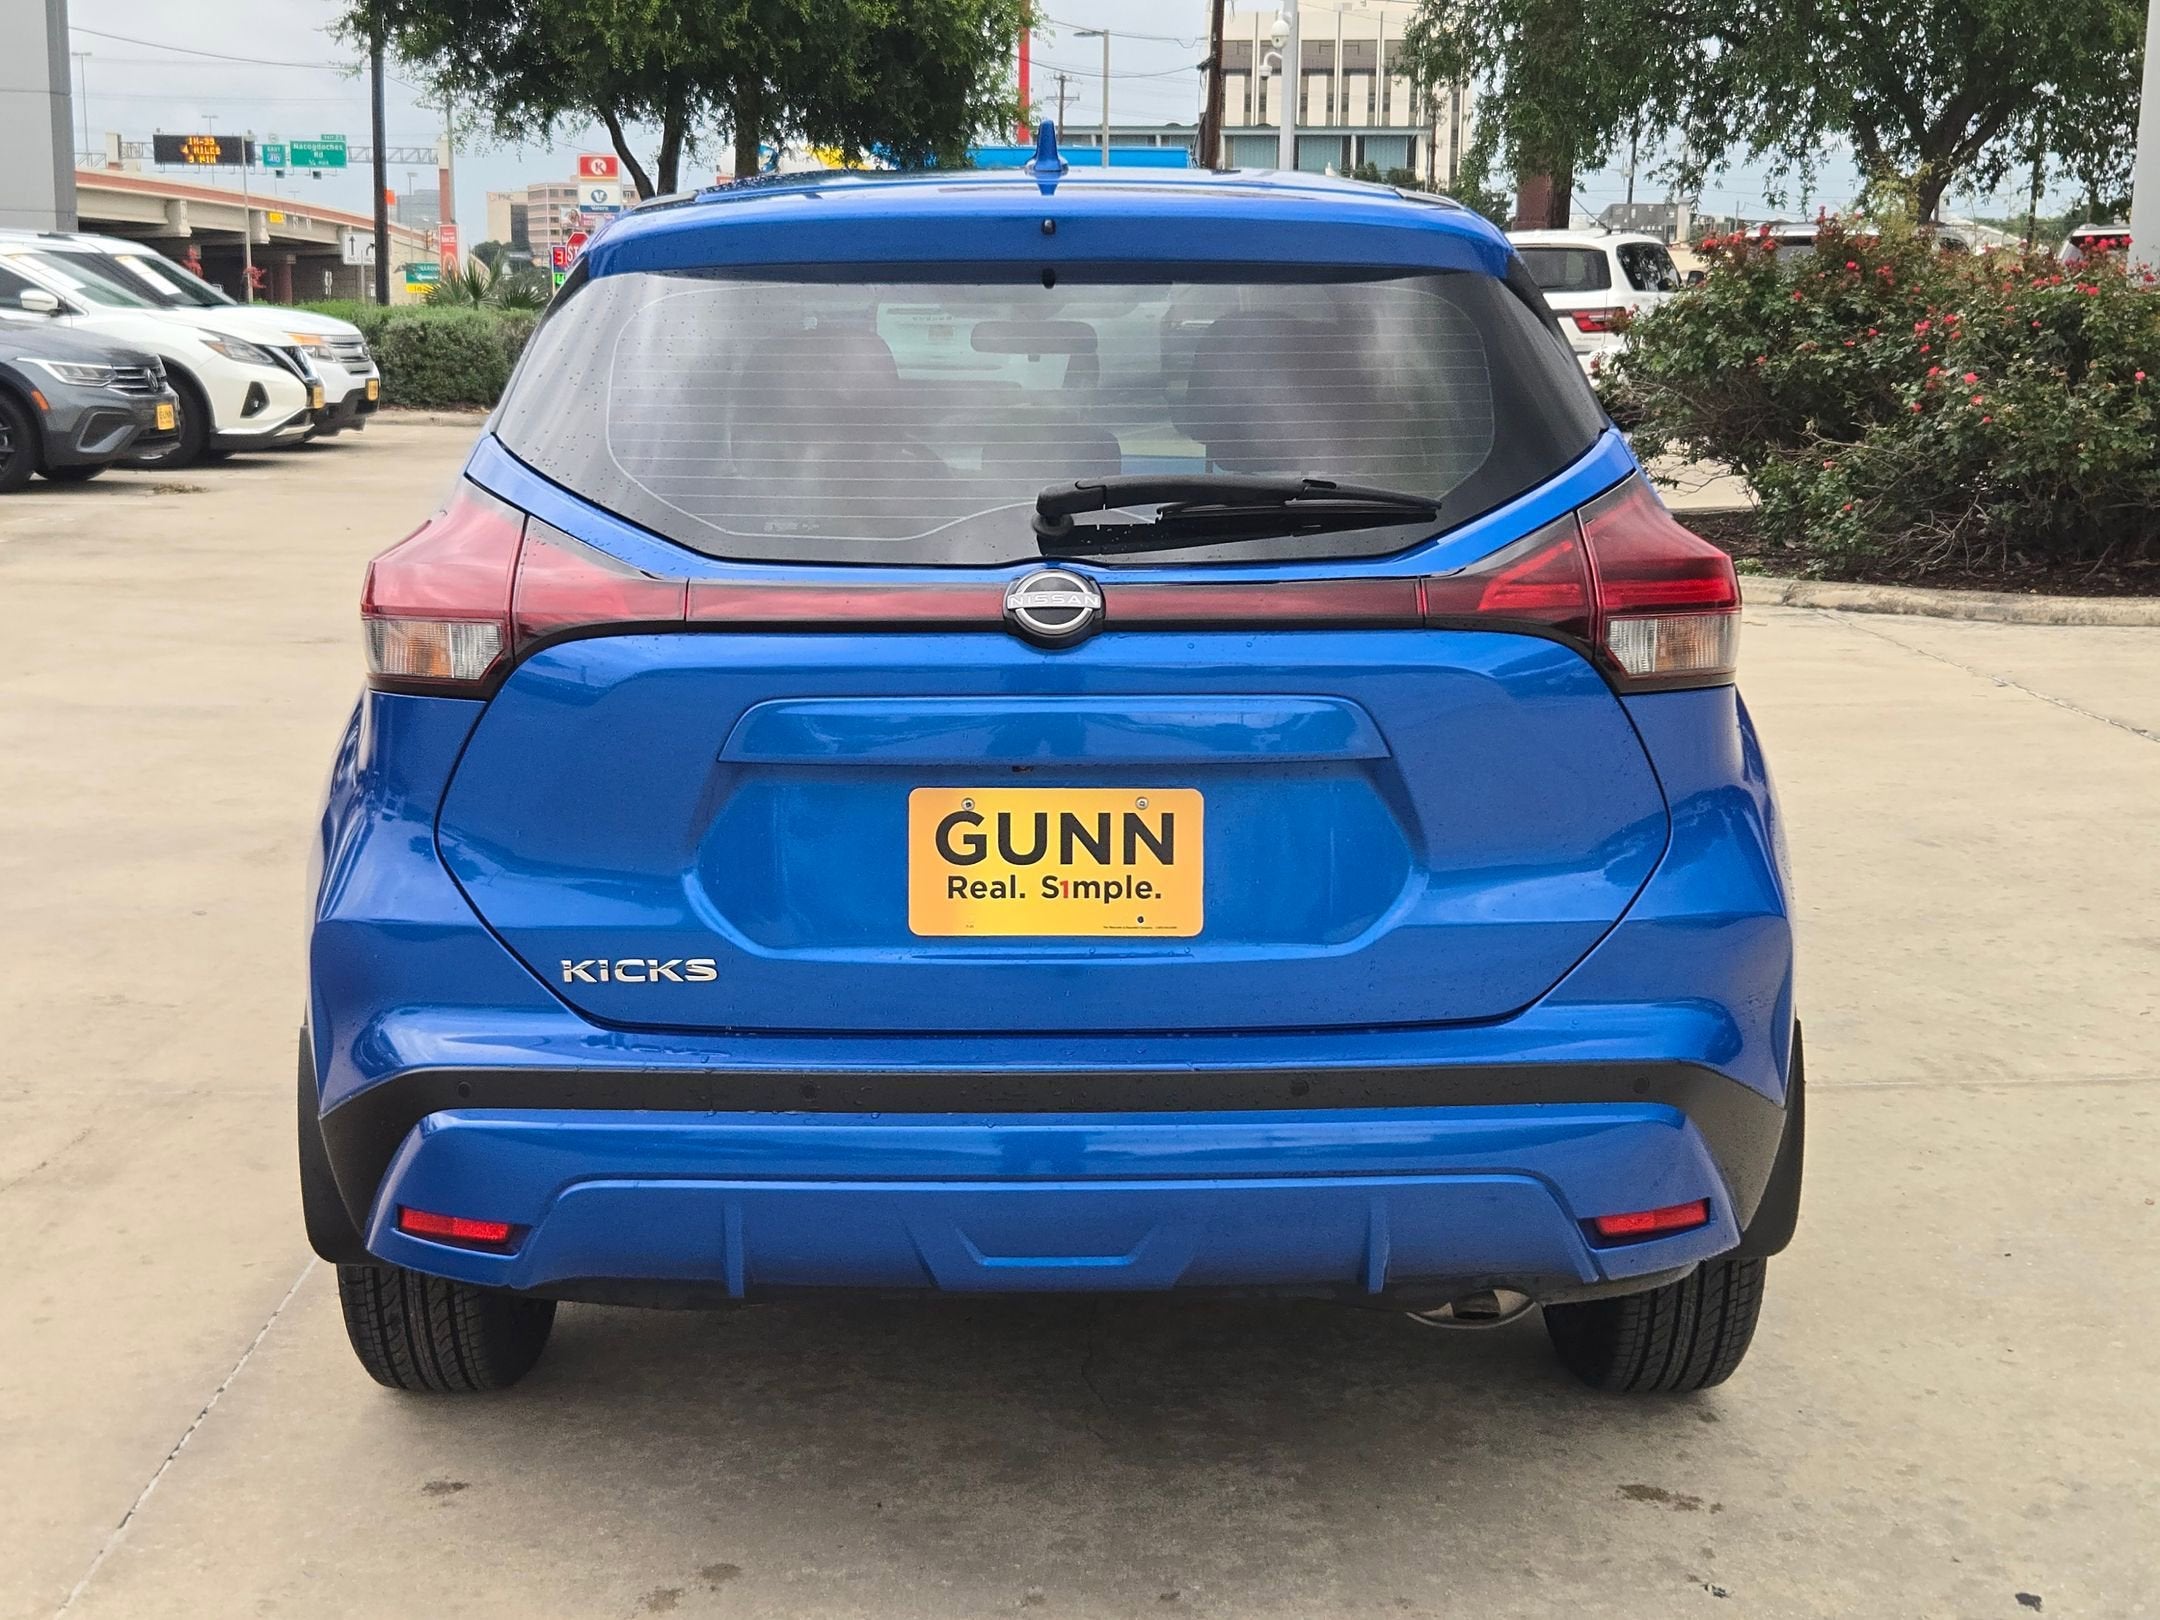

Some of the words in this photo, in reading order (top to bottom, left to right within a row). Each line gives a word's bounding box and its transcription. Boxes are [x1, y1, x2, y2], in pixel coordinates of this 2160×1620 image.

[293, 143, 343, 152] Nacogdoches
[199, 154, 217, 164] MIN
[567, 245, 579, 262] ST
[1010, 594, 1099, 606] NISSAN
[936, 810, 1175, 866] GUNN
[947, 875, 1026, 900] Real.
[1041, 874, 1162, 904] S1mple.
